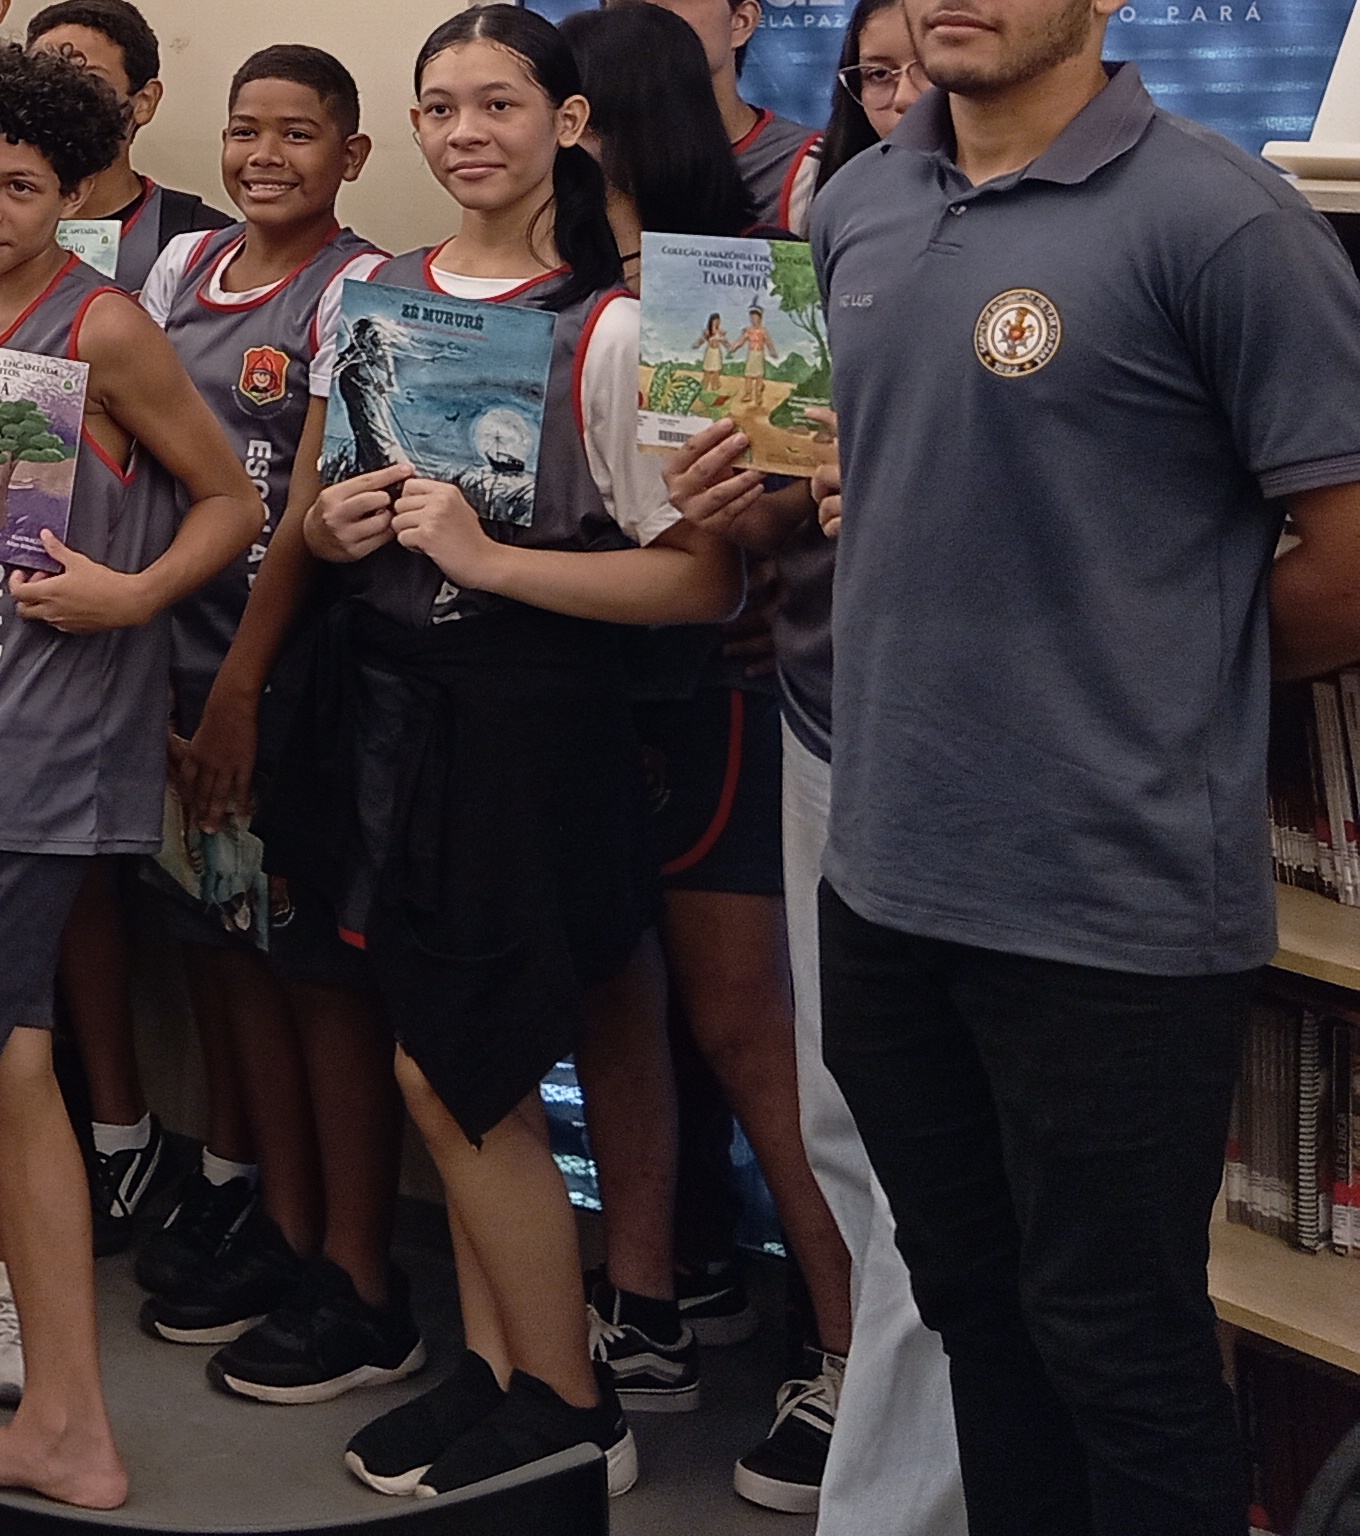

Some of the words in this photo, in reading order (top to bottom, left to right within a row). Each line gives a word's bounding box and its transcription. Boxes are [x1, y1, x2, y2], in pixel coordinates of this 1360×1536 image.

[758, 15, 794, 28] ELA
[804, 14, 847, 28] PAZ
[1119, 6, 1136, 23] O
[1167, 2, 1262, 22] PARÁ
[702, 270, 769, 292] TAMBATAJÁ
[401, 303, 419, 320] ZÉ
[422, 307, 484, 331] MURURÉ
